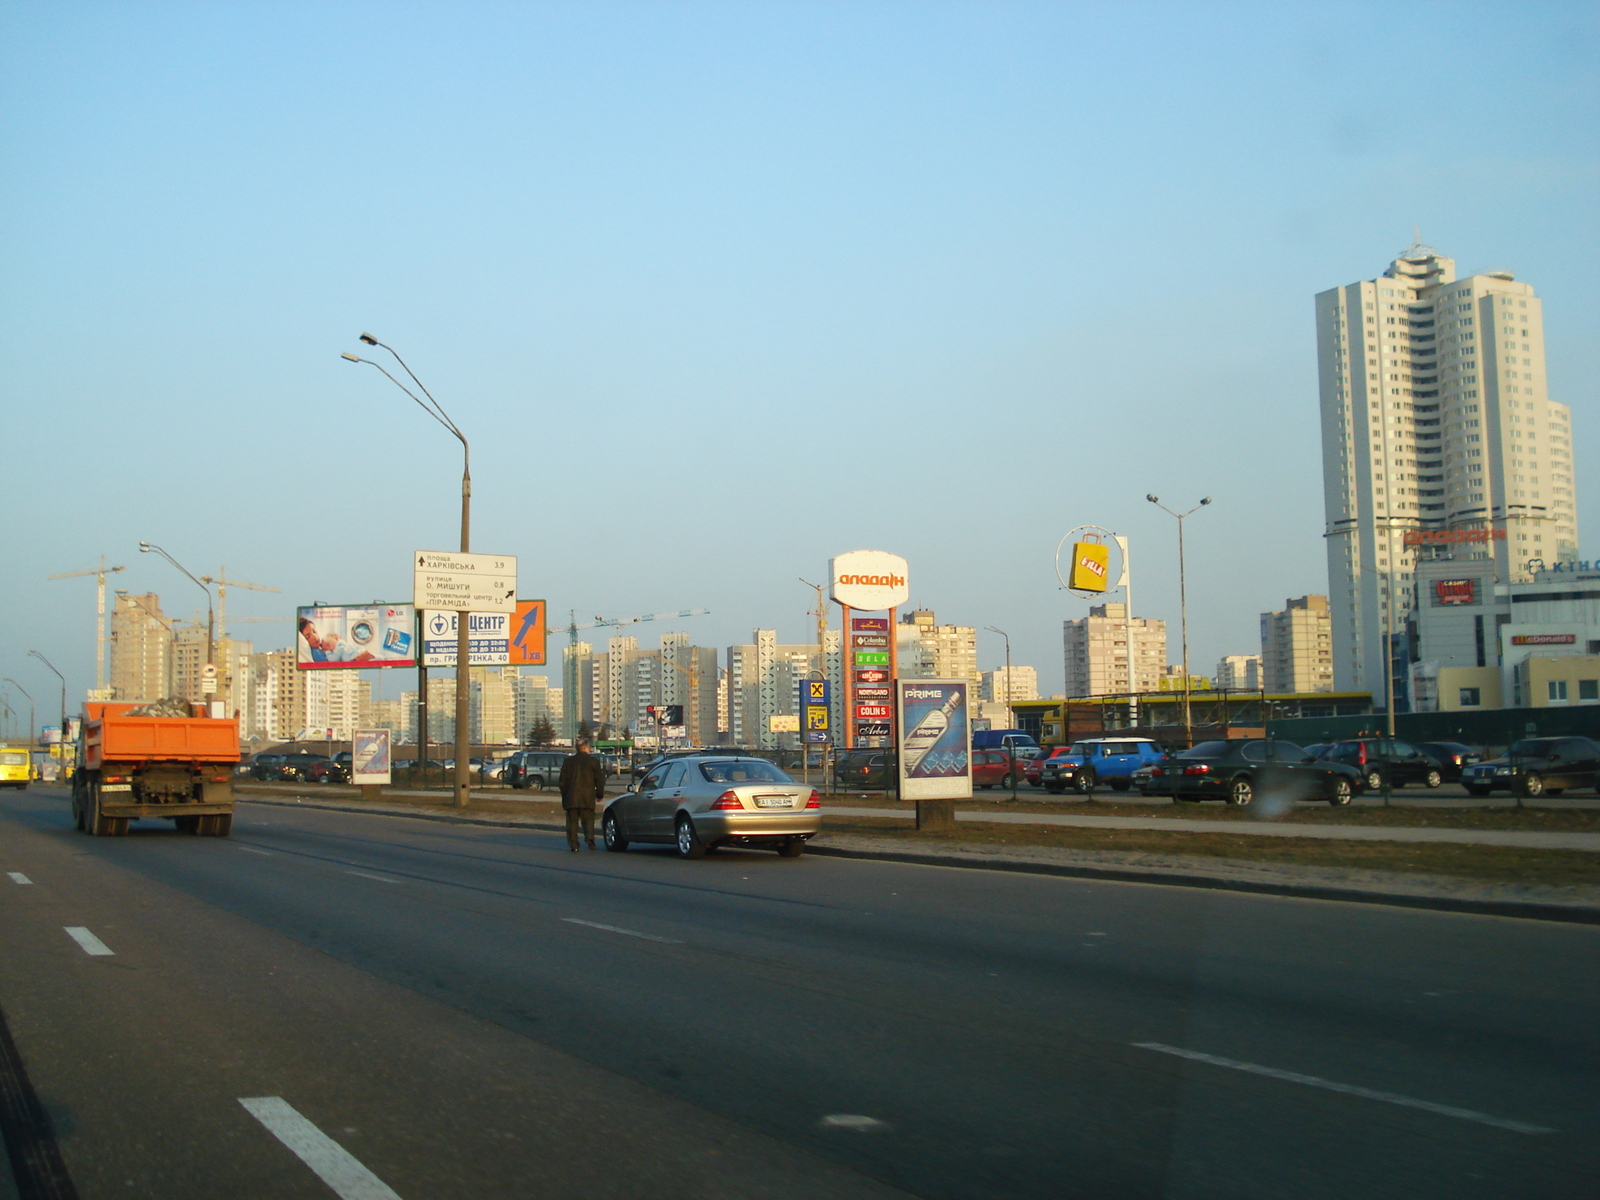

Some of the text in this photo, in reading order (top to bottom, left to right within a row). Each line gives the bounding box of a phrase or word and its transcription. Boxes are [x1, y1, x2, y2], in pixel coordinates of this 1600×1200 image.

[427, 562, 476, 570] ХАРКІВСЬКА
[521, 644, 528, 659] 1
[860, 724, 888, 735] Arber
